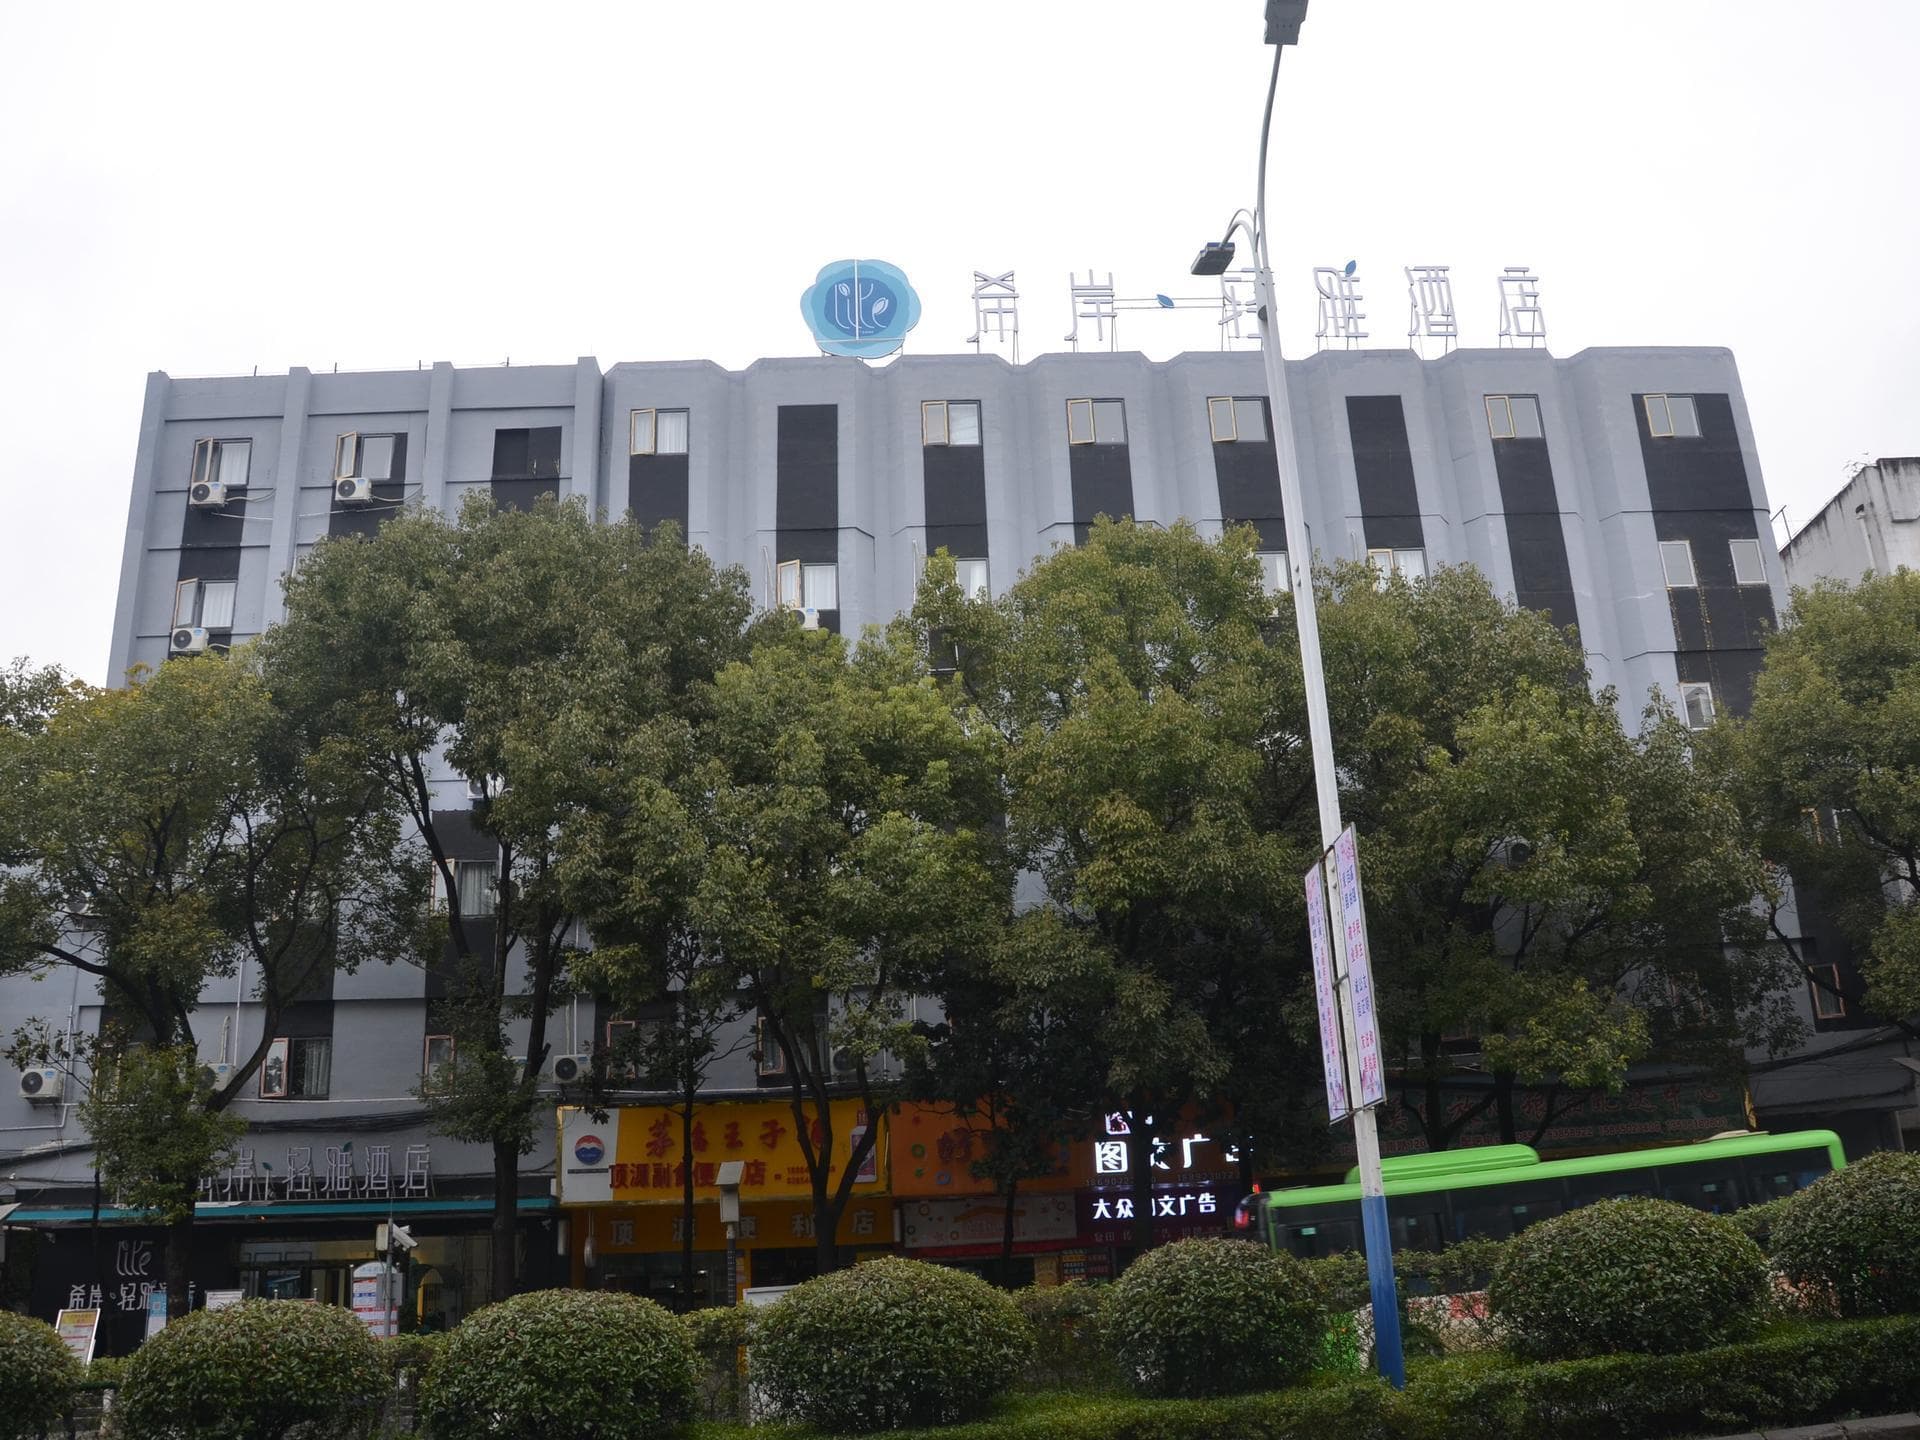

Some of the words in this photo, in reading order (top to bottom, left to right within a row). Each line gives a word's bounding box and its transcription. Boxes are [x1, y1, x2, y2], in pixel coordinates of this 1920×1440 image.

[608, 1159, 767, 1190] 顶源副食便店
[1092, 1192, 1217, 1220] 大众文广告
